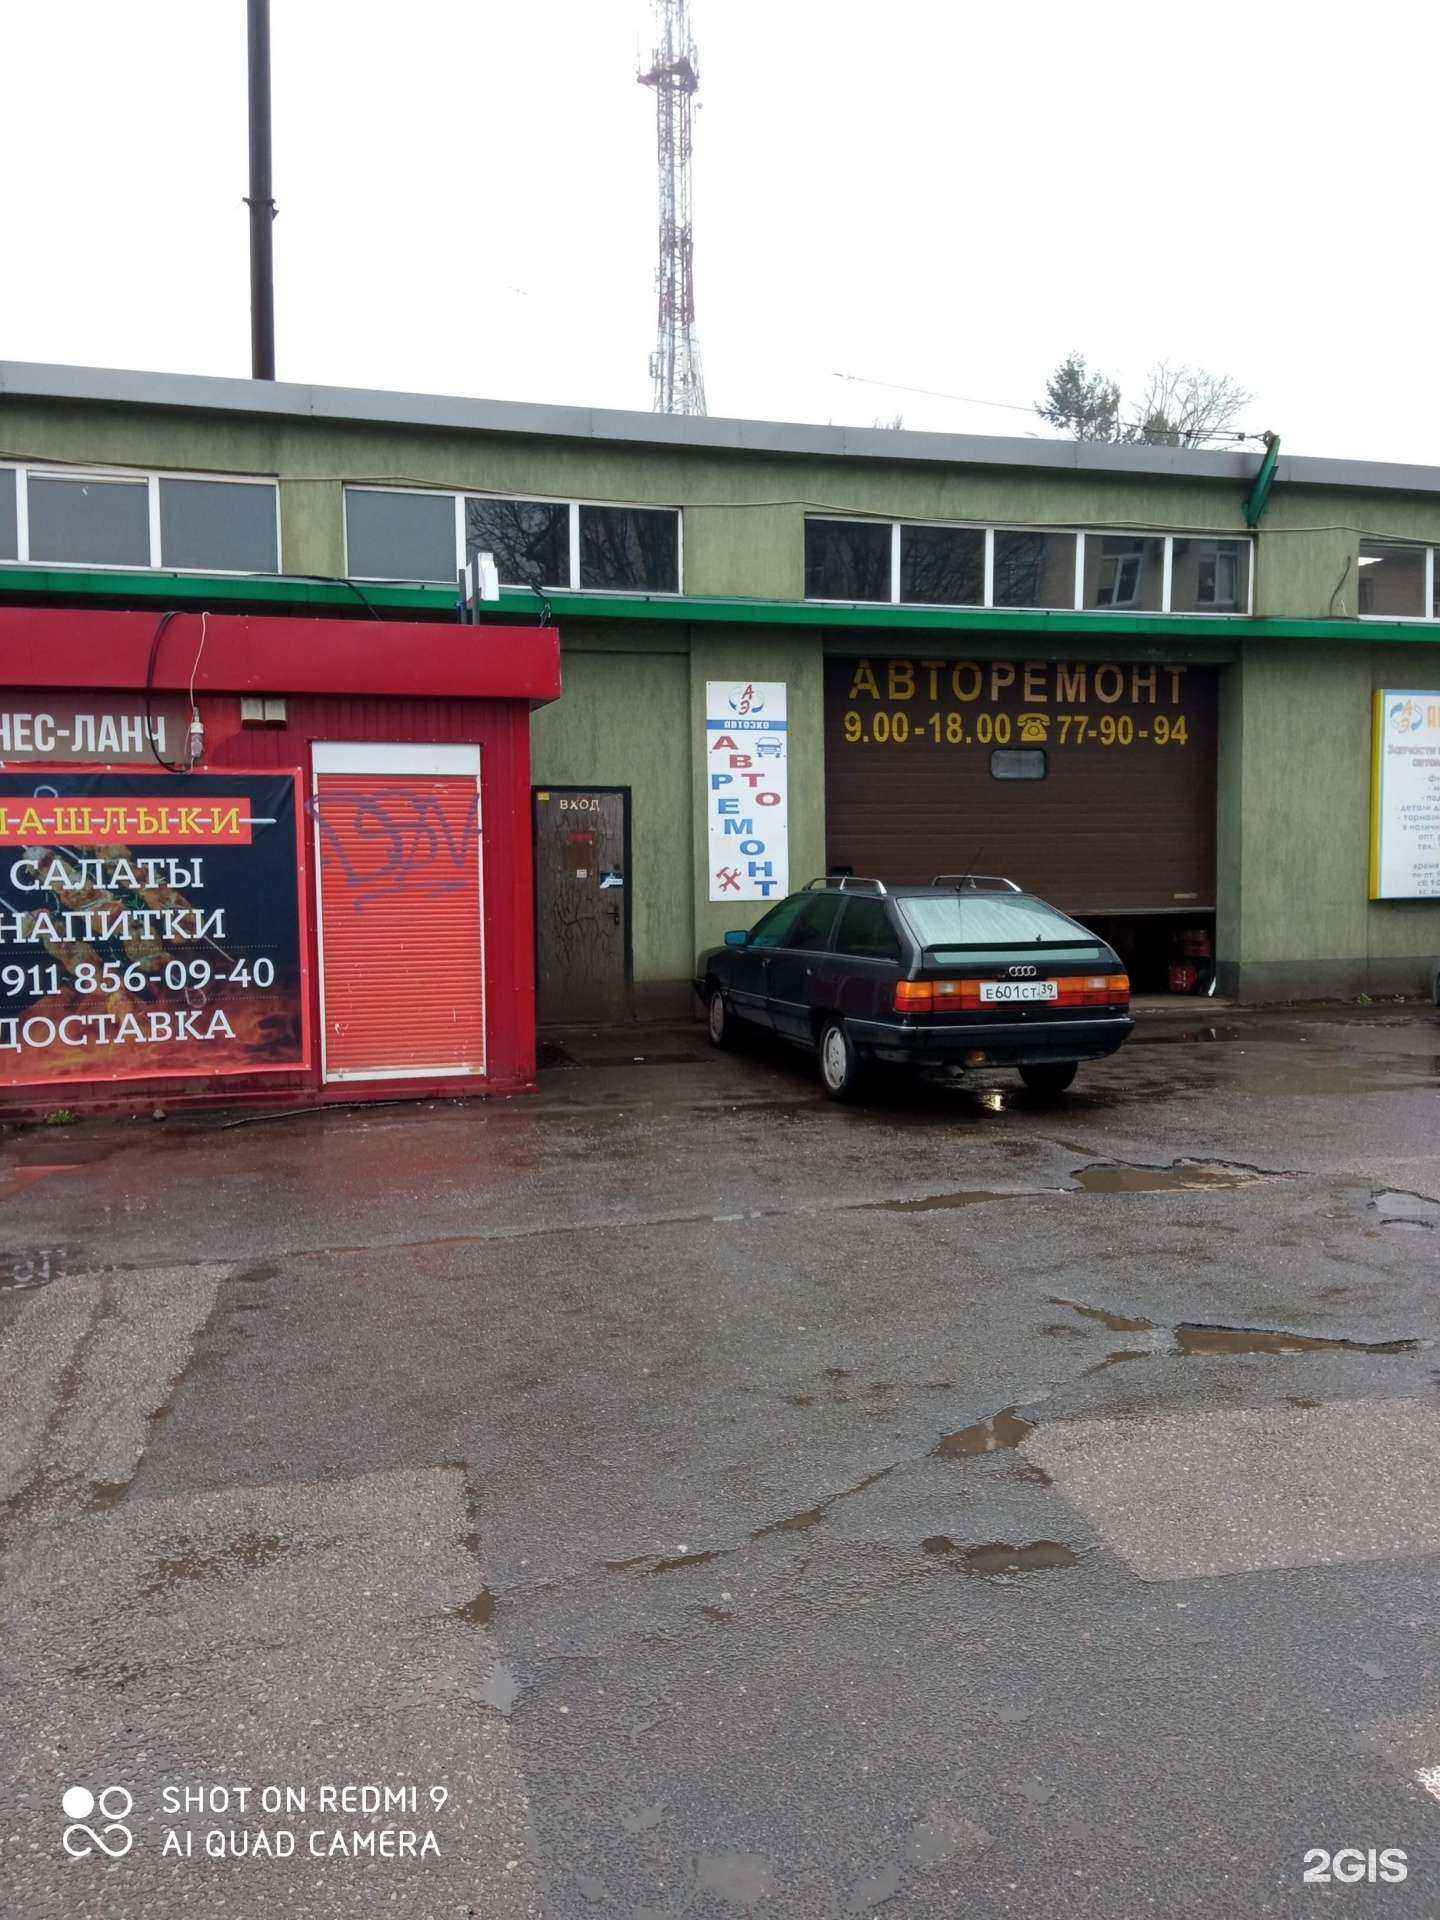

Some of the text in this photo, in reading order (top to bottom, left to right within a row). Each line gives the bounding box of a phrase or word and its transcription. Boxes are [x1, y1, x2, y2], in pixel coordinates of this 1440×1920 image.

[848, 658, 1187, 704] АВТОРЕМОНТ
[1057, 715, 1189, 745] 77-90-94
[0, 807, 240, 835] АШЛЫКИ
[559, 799, 600, 812] ВХОД
[10, 857, 204, 891] САЛАТЫ
[0, 908, 226, 944] НАПИТКИ
[2, 957, 274, 996] 911 856-09-40
[986, 984, 1054, 999] Е601СТ 39
[0, 1009, 235, 1053] ДОСТАВКА
